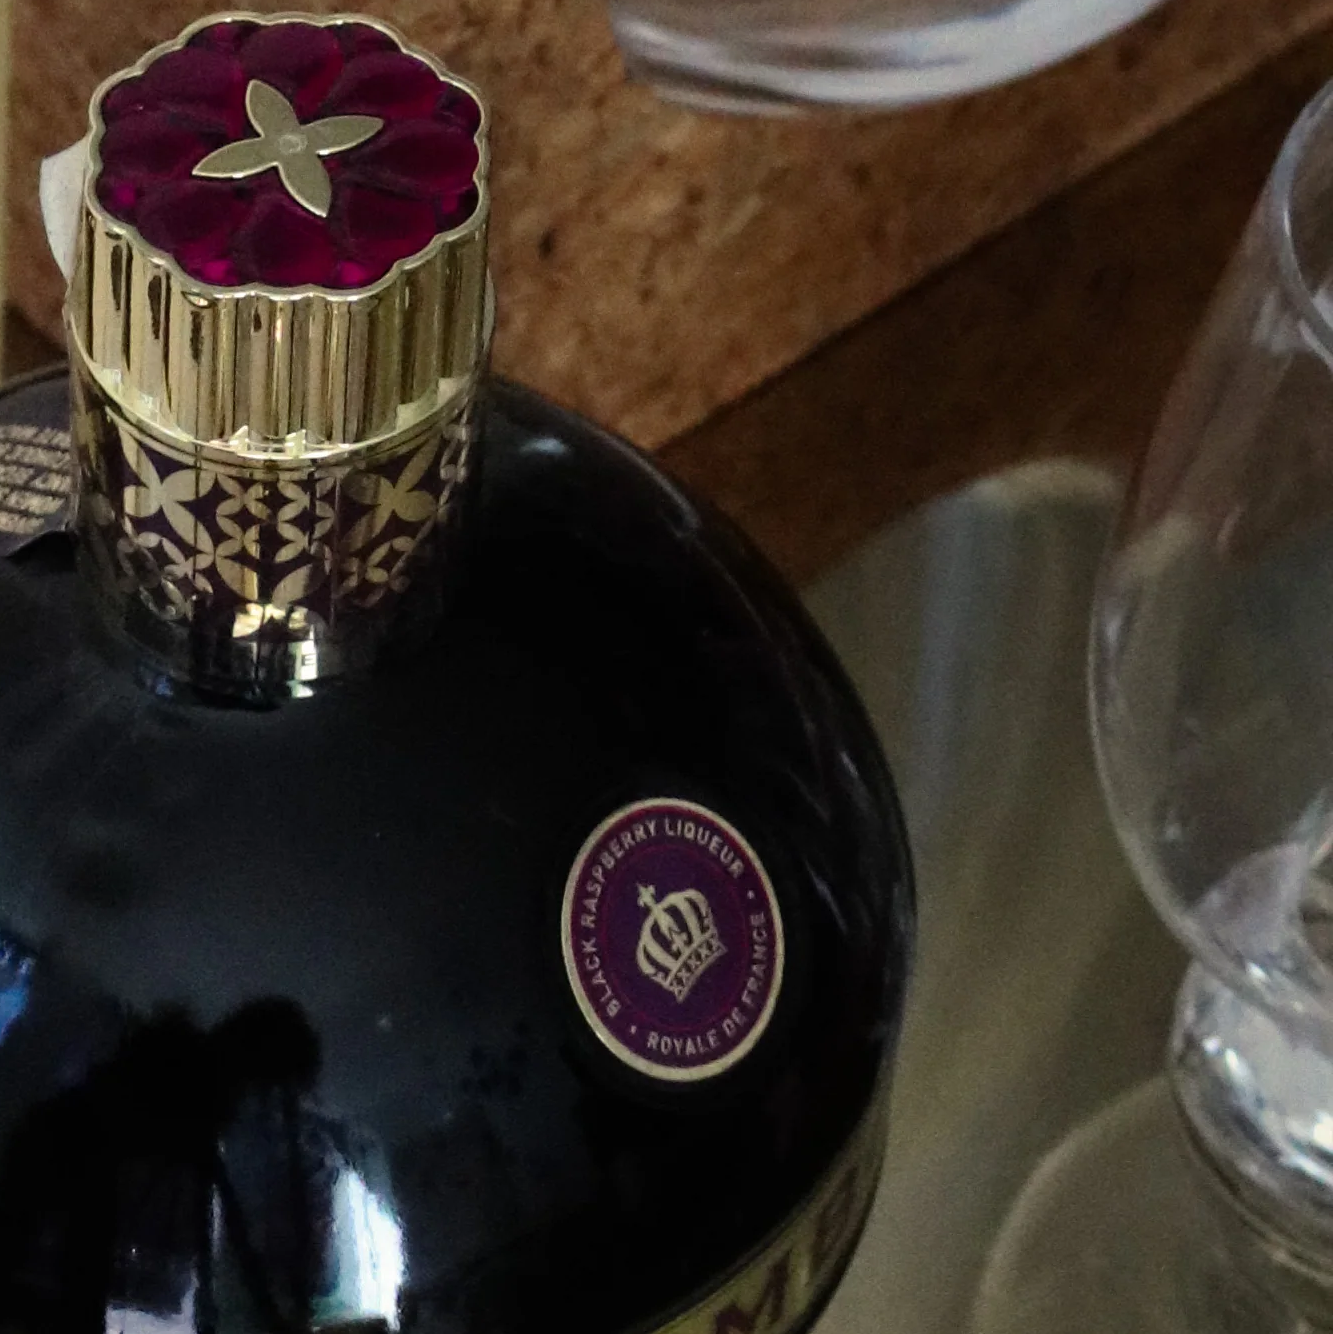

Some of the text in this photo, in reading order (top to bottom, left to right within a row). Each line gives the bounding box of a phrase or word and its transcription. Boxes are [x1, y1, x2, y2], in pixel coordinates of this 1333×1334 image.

[581, 816, 745, 1017] BLACK RASPBERRY LIQUEUR
[646, 910, 766, 1057] ROYALE DE FRANCE
